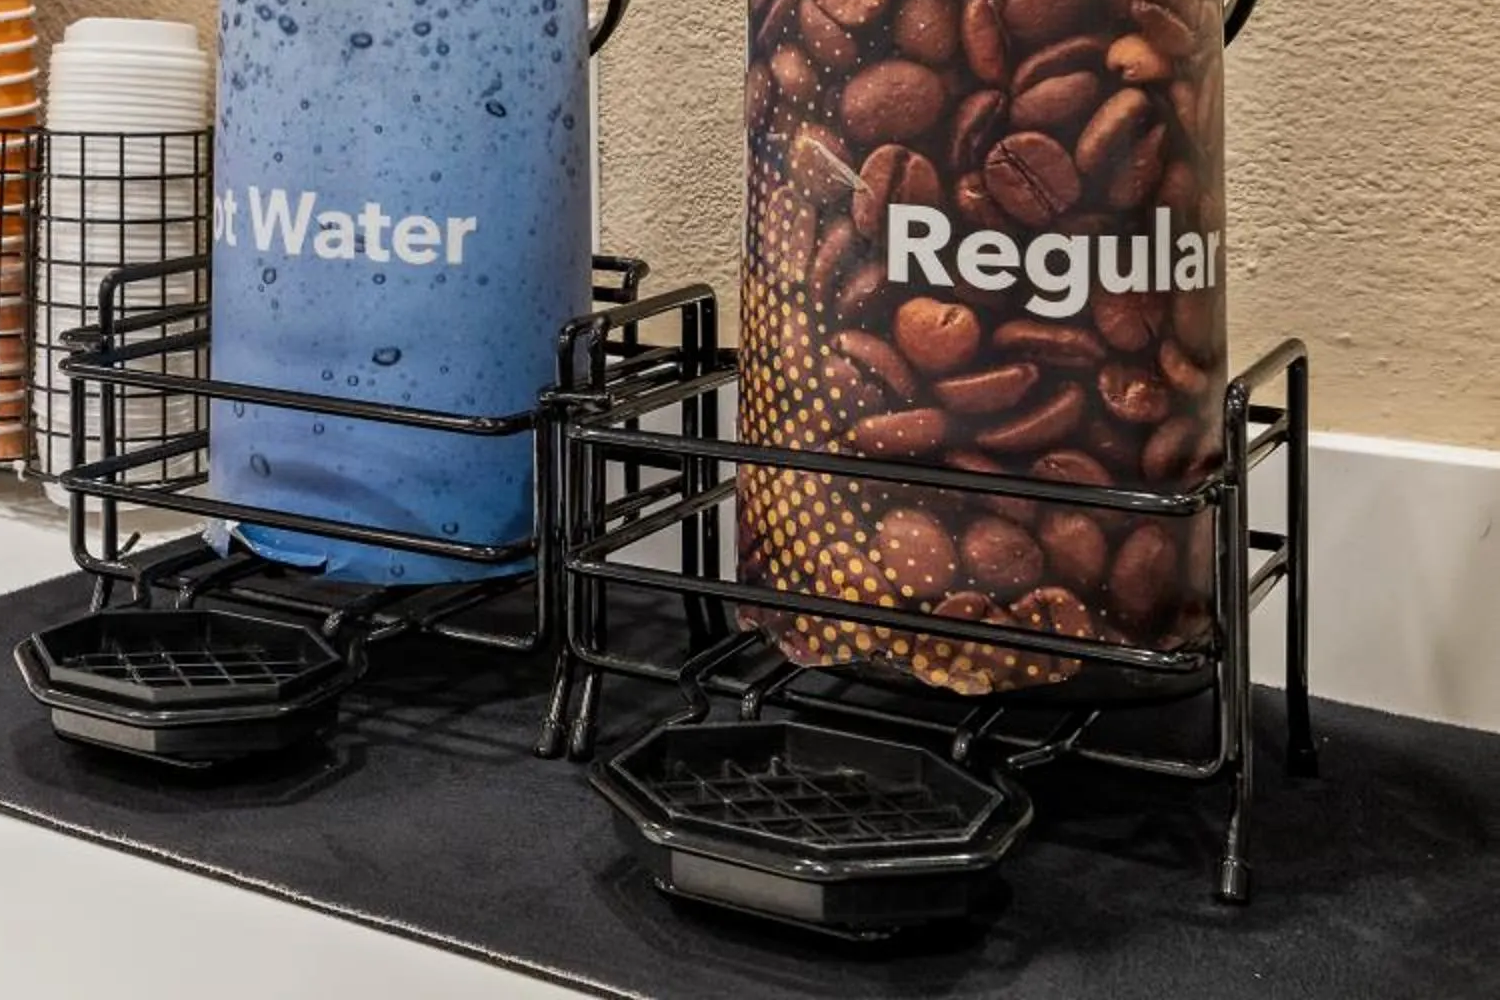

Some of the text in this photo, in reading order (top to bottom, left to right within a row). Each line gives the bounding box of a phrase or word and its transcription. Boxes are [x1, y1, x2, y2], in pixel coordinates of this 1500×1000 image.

[213, 186, 477, 265] ot Water
[887, 203, 1221, 319] Regular
